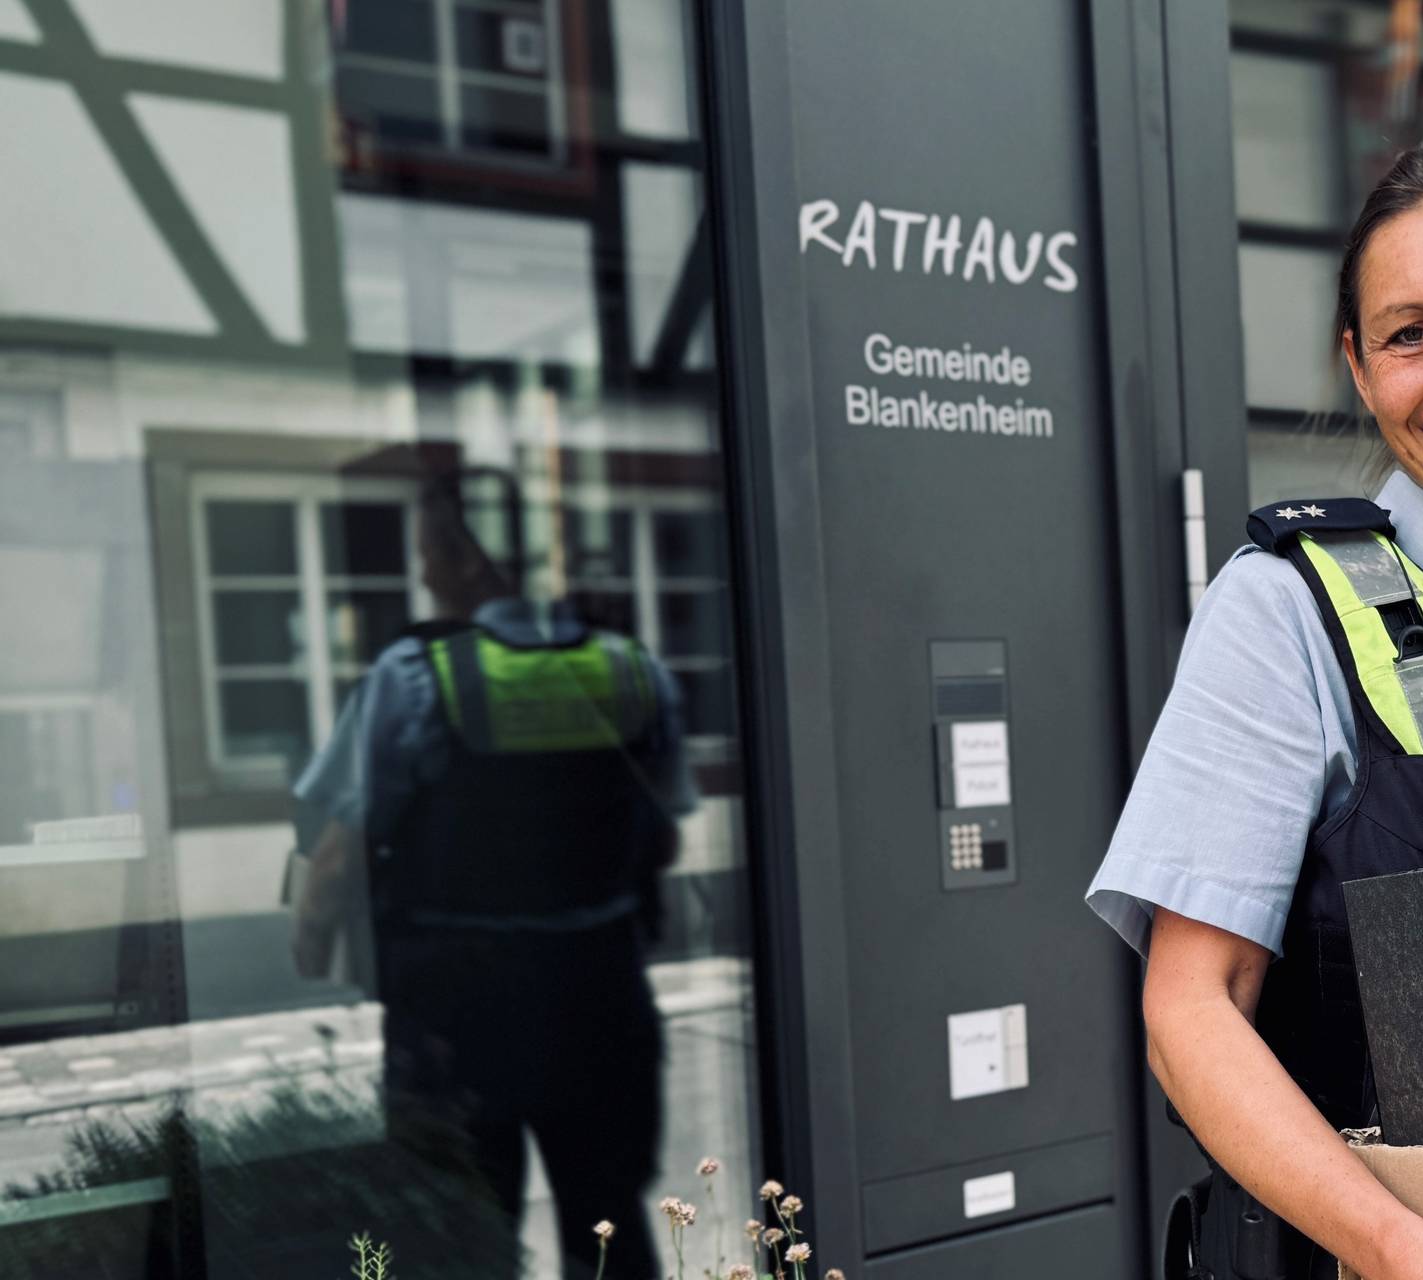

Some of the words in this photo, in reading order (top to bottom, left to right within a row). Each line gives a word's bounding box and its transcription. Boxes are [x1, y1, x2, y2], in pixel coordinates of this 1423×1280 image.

[799, 199, 1079, 292] RATHAUS
[864, 333, 1031, 386] Gemeinde
[845, 385, 1053, 438] Blankenheim
